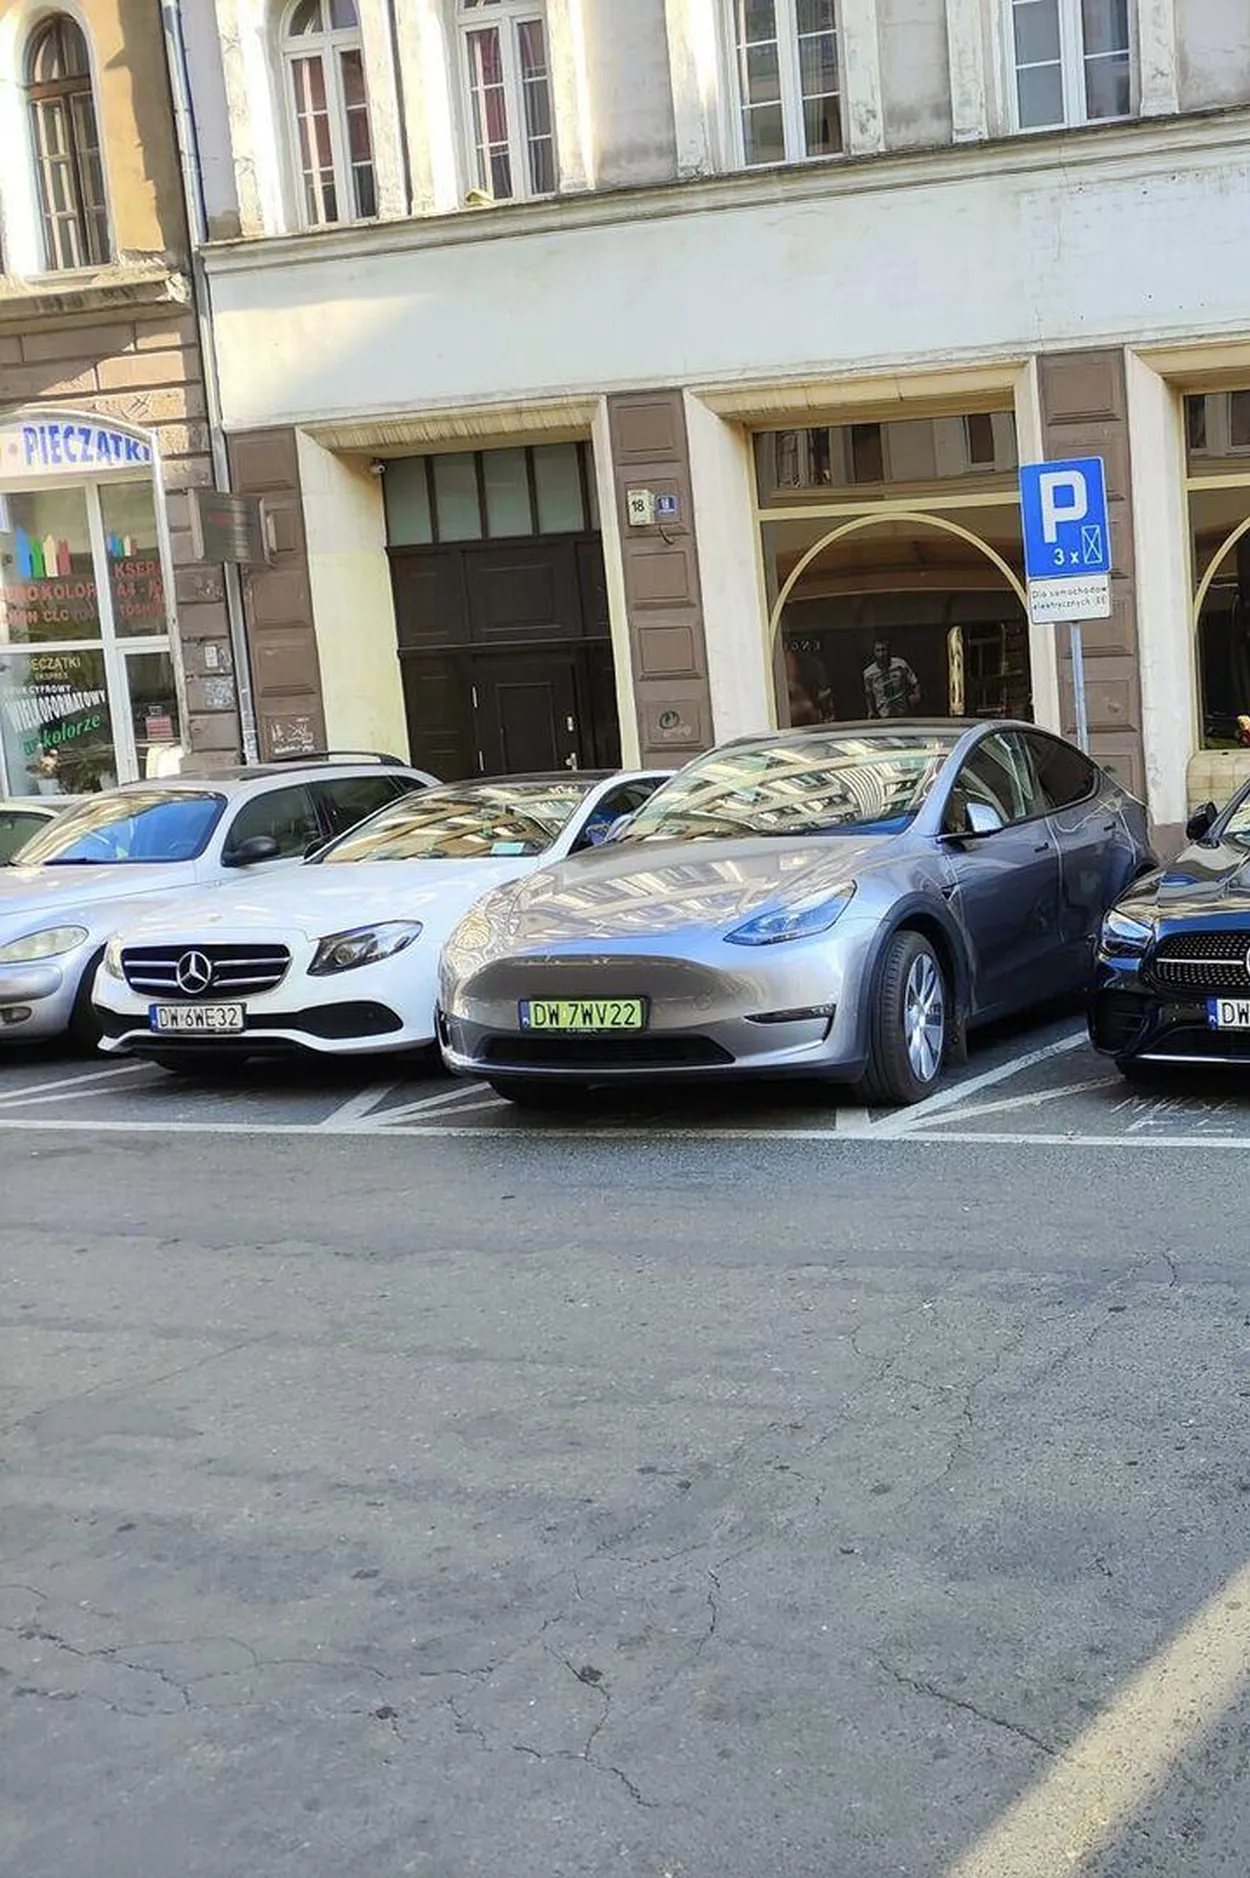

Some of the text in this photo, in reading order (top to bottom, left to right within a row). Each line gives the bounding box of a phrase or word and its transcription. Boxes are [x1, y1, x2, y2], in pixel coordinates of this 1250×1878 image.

[632, 499, 645, 512] 18
[1039, 470, 1088, 543] P
[1054, 548, 1065, 565] 3
[43, 714, 100, 749] kolorze
[159, 1007, 238, 1027] DW 6WE32
[534, 1003, 636, 1026] DW 7WV22
[1222, 1002, 1249, 1024] DW
